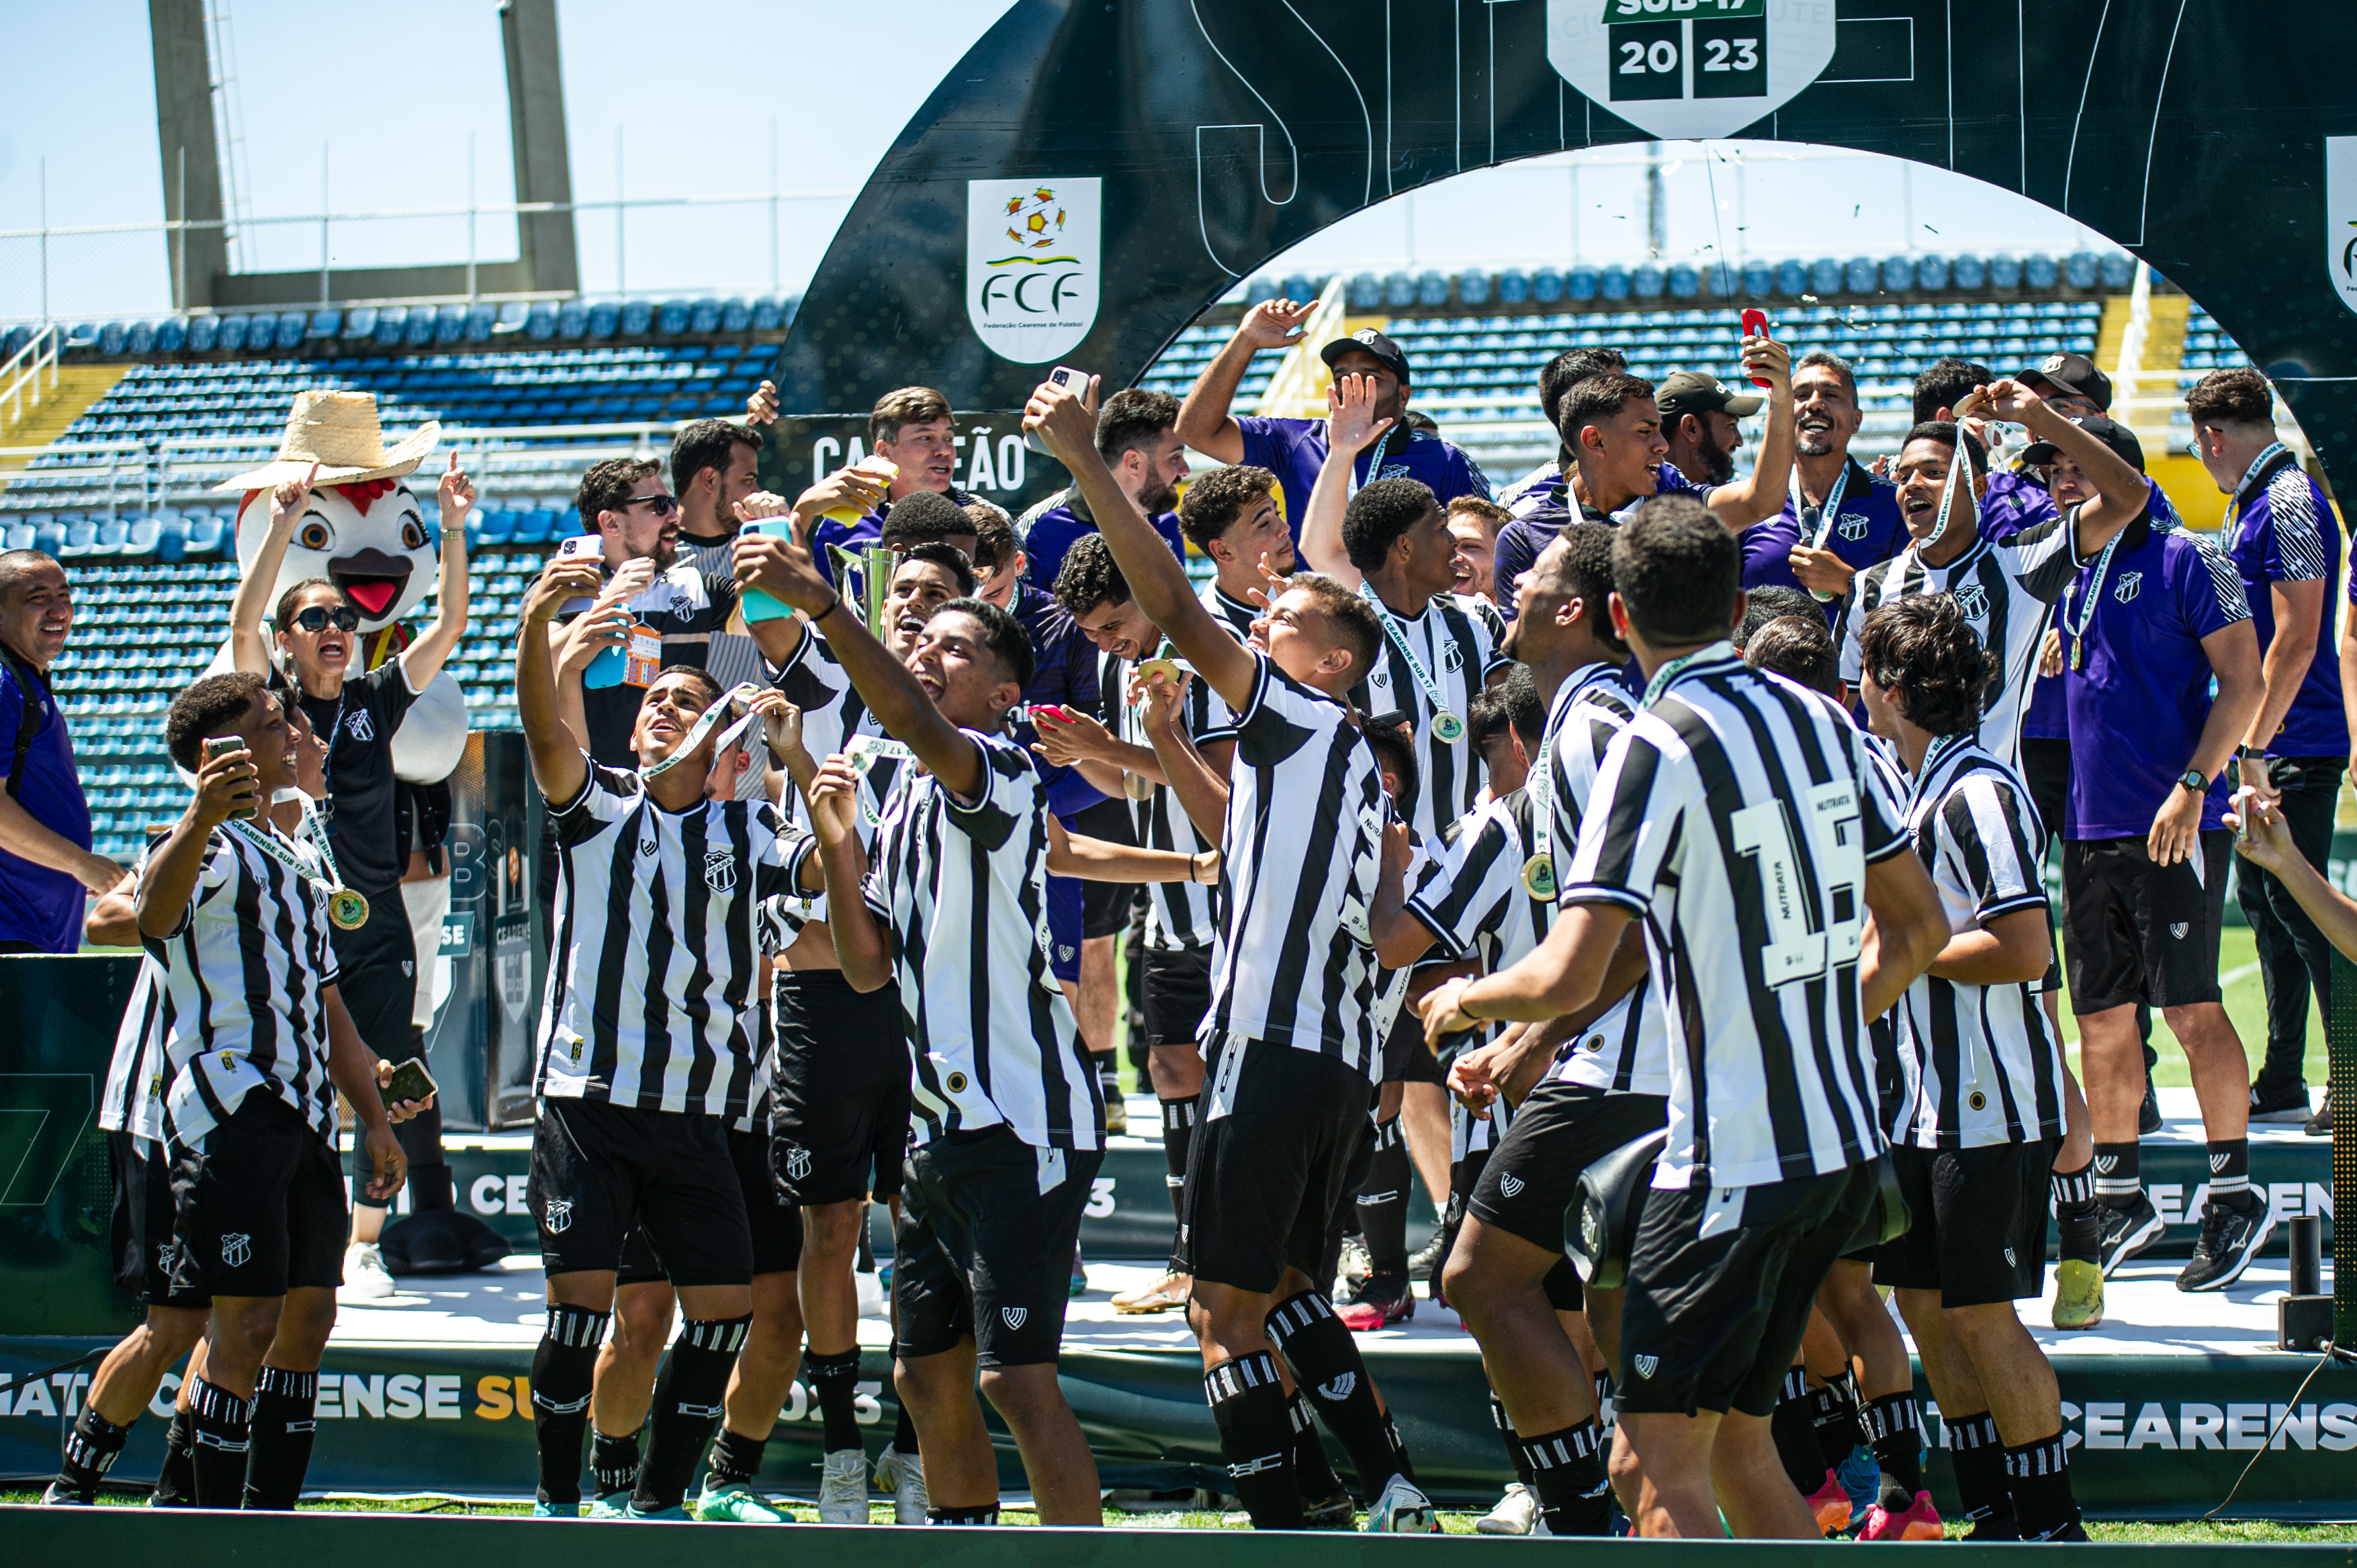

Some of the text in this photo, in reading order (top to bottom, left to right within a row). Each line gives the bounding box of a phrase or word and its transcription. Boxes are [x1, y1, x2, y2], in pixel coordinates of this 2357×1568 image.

[1619, 38, 1759, 74] 20 23
[981, 273, 1085, 316] FCF
[813, 426, 1025, 491] CAEÃO
[2086, 567, 2103, 610] CEARENSE
[2102, 549, 2110, 565] SUB
[1386, 622, 1433, 689] CEARENSE SUB 17
[1926, 734, 1951, 765] SUB 17
[232, 820, 304, 873] CEARENSE SUB 17
[310, 817, 320, 837] SUB
[1730, 779, 1866, 990] 15
[1775, 861, 1791, 921] NUTRATA
